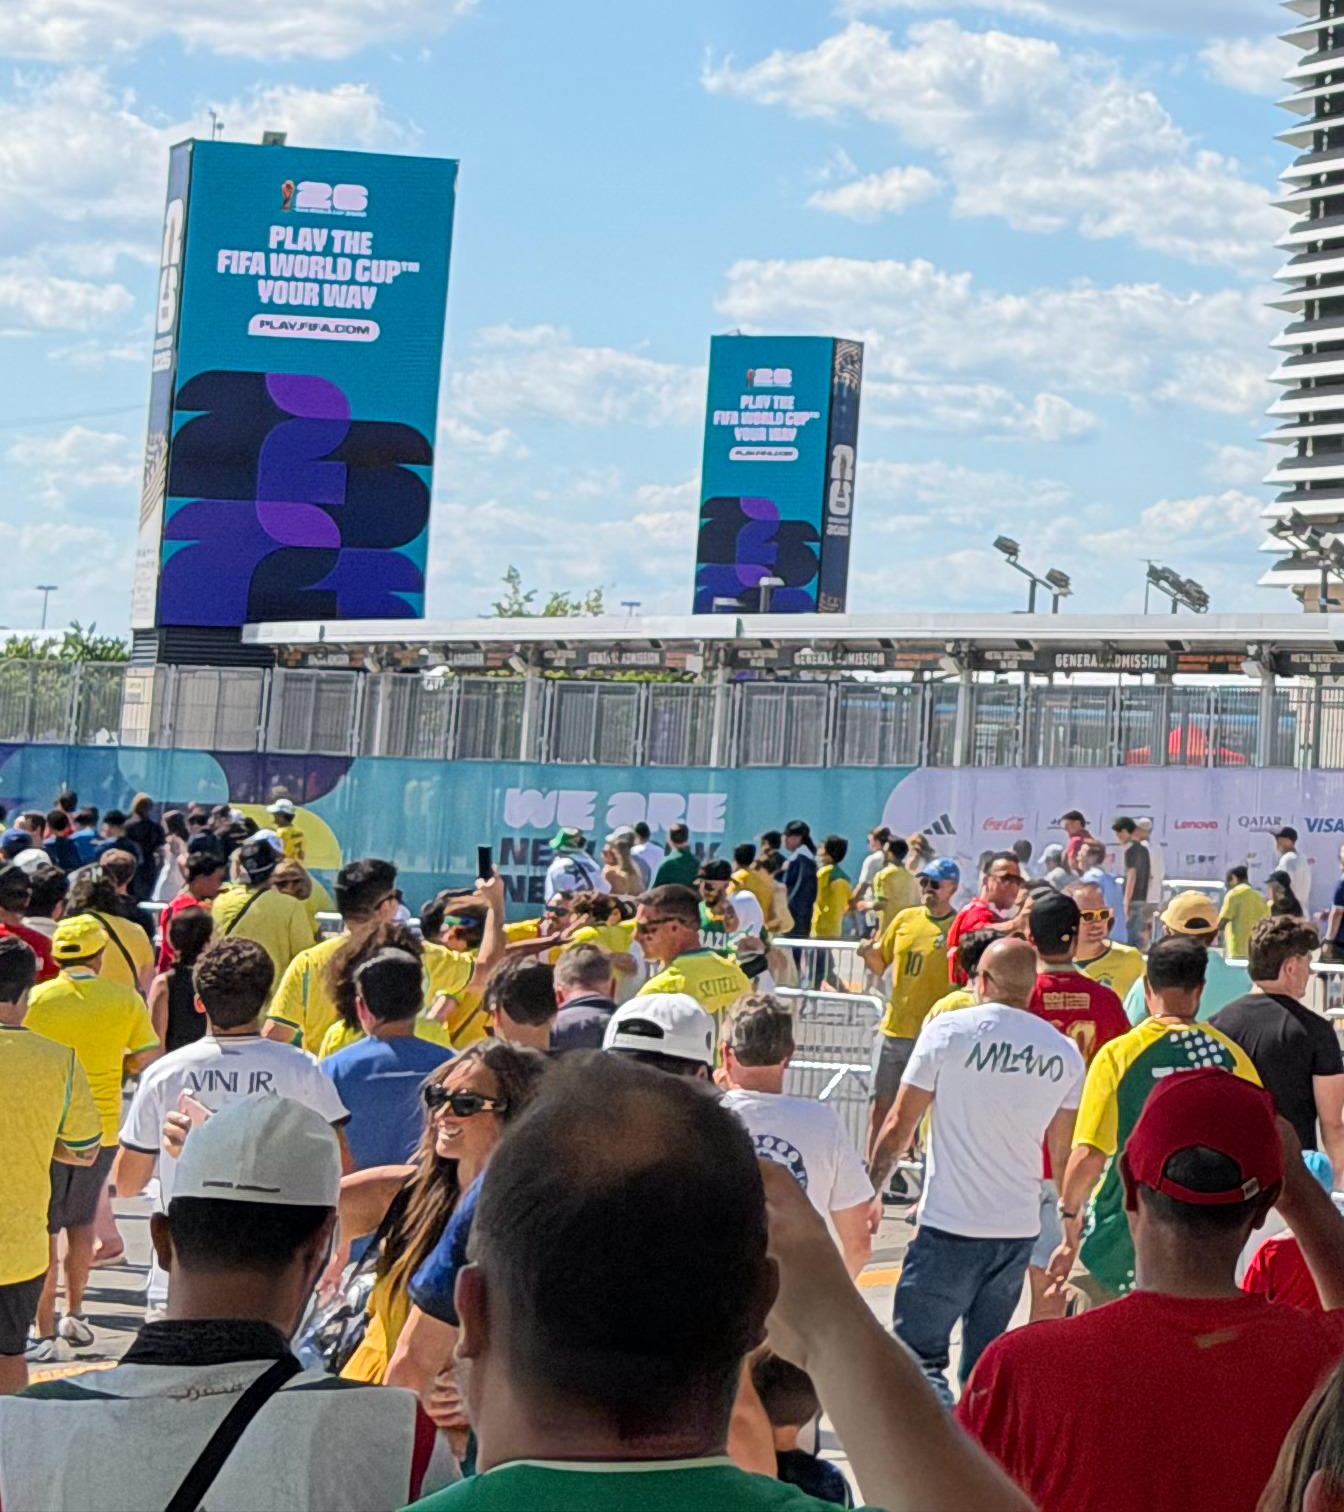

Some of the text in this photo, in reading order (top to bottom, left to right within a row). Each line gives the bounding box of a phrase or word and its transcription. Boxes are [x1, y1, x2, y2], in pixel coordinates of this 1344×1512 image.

[269, 225, 374, 255] PLAY THE
[217, 249, 266, 275] FIFA
[268, 253, 352, 281] WORLD
[257, 279, 377, 310] YOUR WAY
[504, 788, 727, 833] WE ARE
[1238, 815, 1282, 828] QATAR
[1174, 820, 1218, 830] Lenovo
[1304, 817, 1344, 833] VISA
[905, 951, 924, 977] 10
[190, 1070, 238, 1093] VINI
